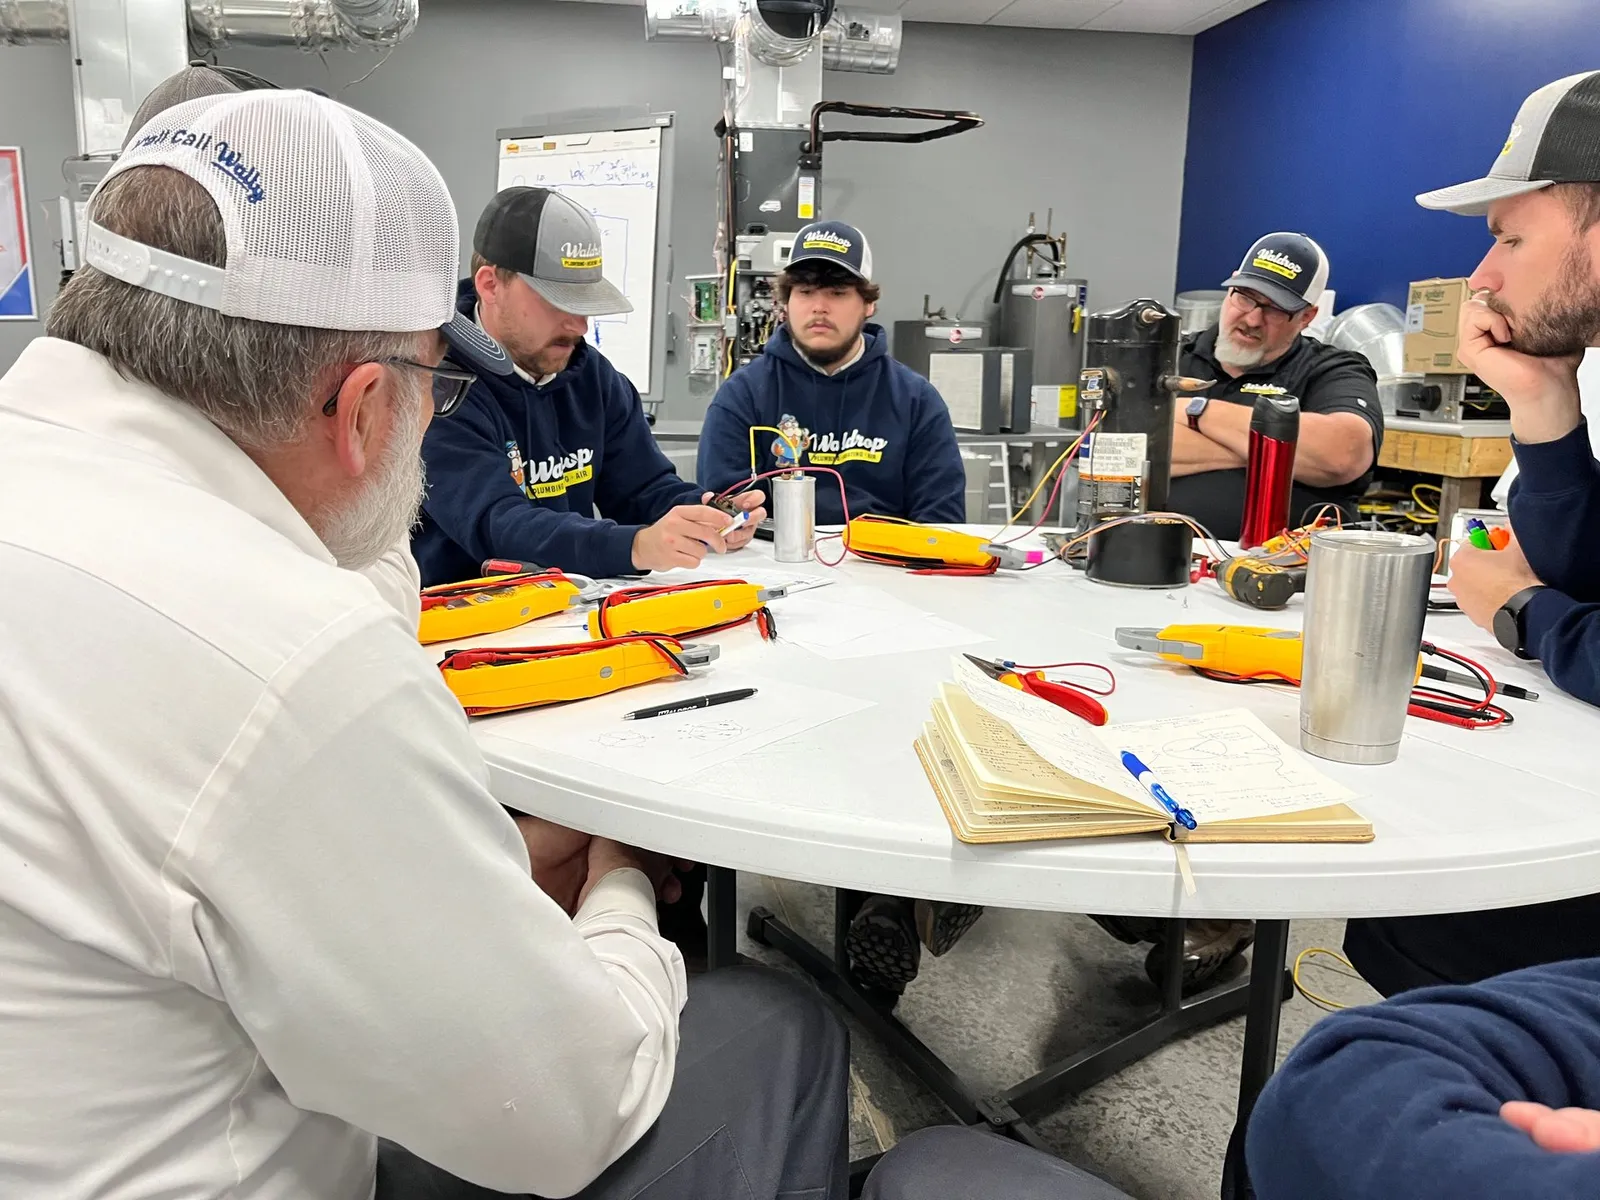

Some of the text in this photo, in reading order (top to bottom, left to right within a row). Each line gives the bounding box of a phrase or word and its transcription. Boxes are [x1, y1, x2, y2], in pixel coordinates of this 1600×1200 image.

[171, 129, 212, 150] Call
[212, 141, 266, 204] Wally
[803, 230, 852, 248] Waldrop
[560, 242, 602, 258] Waldr
[1256, 248, 1303, 273] Waldrop
[576, 470, 588, 480] AIR
